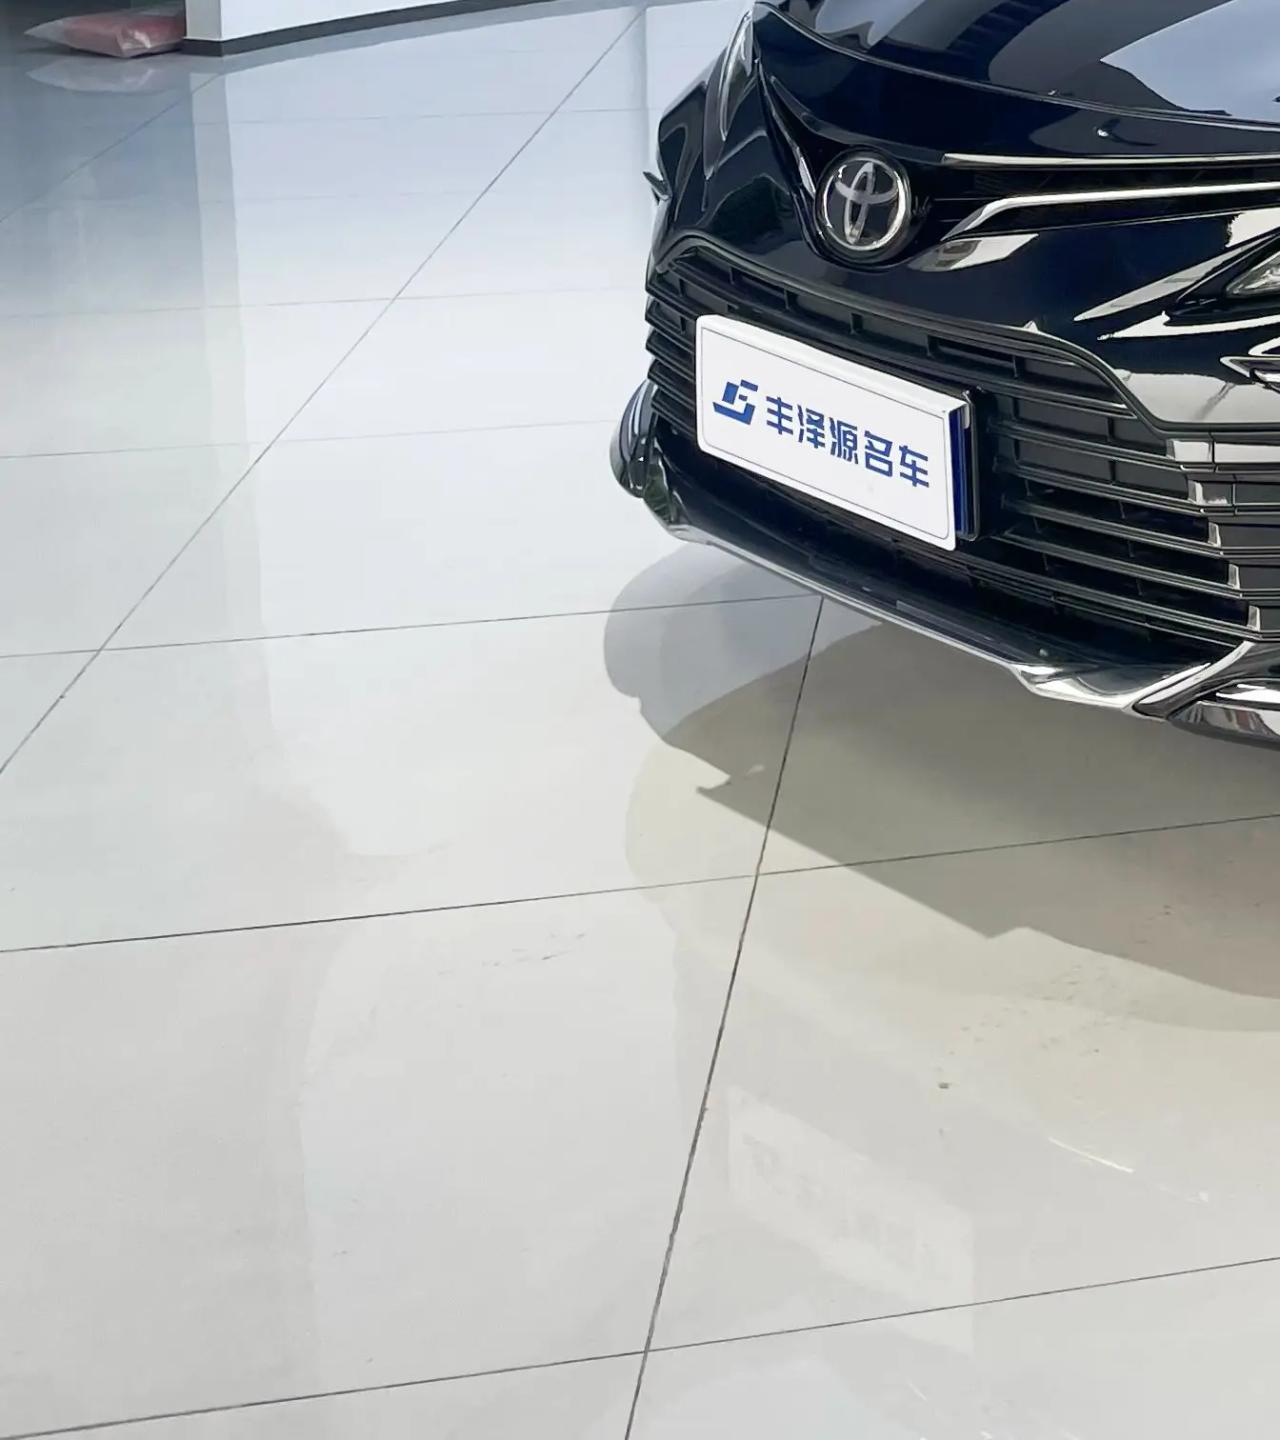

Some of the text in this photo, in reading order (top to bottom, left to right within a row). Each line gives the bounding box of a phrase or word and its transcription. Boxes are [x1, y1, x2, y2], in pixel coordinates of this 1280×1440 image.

[765, 395, 930, 488] 丰泽源名车
